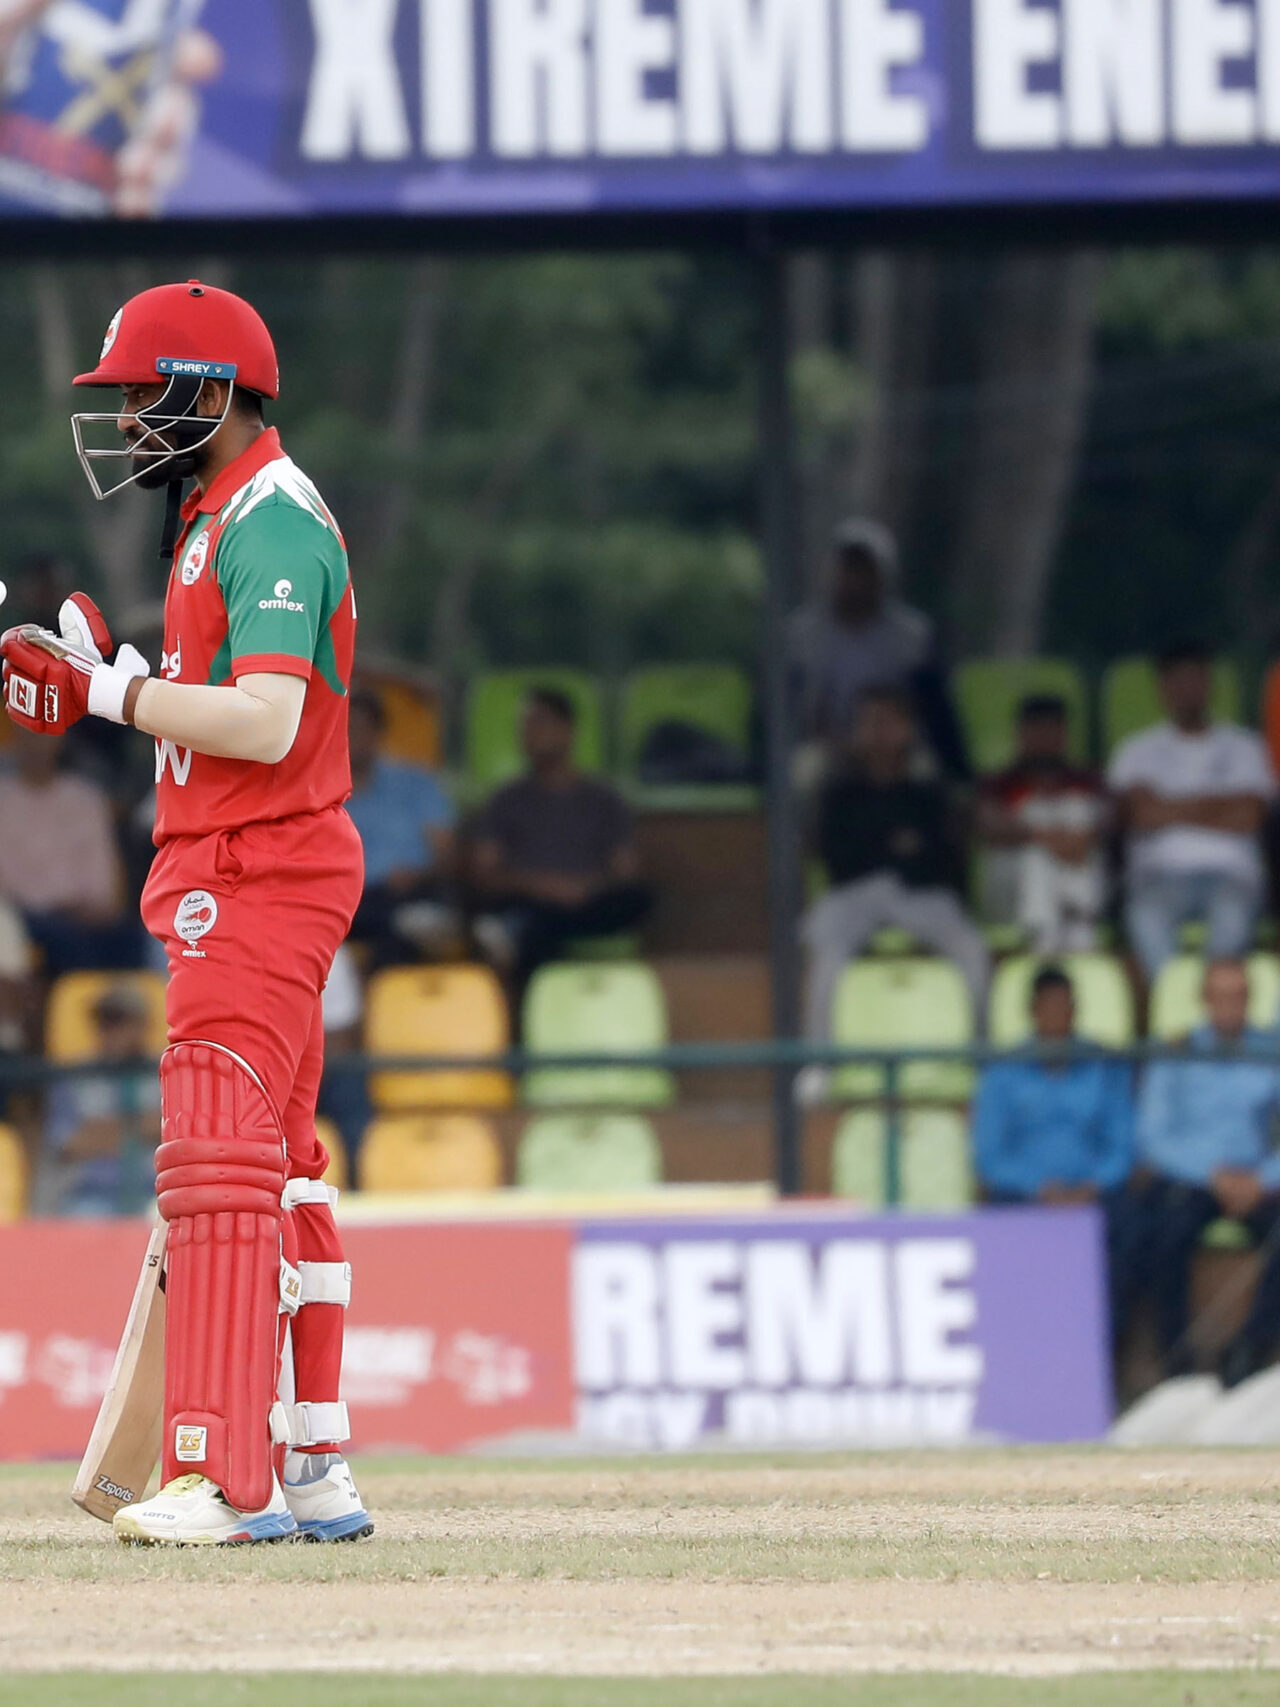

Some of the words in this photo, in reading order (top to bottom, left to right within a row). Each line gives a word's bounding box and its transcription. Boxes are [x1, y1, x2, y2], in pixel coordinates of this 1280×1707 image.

[299, 0, 929, 160] XTREME
[974, 0, 1280, 151] ENE
[171, 361, 211, 374] SHREY
[258, 598, 304, 613] omtex
[572, 1239, 982, 1389] REME
[178, 1433, 201, 1452] ZS
[94, 1474, 136, 1504] Zsports
[141, 1510, 177, 1521] LOTTO
